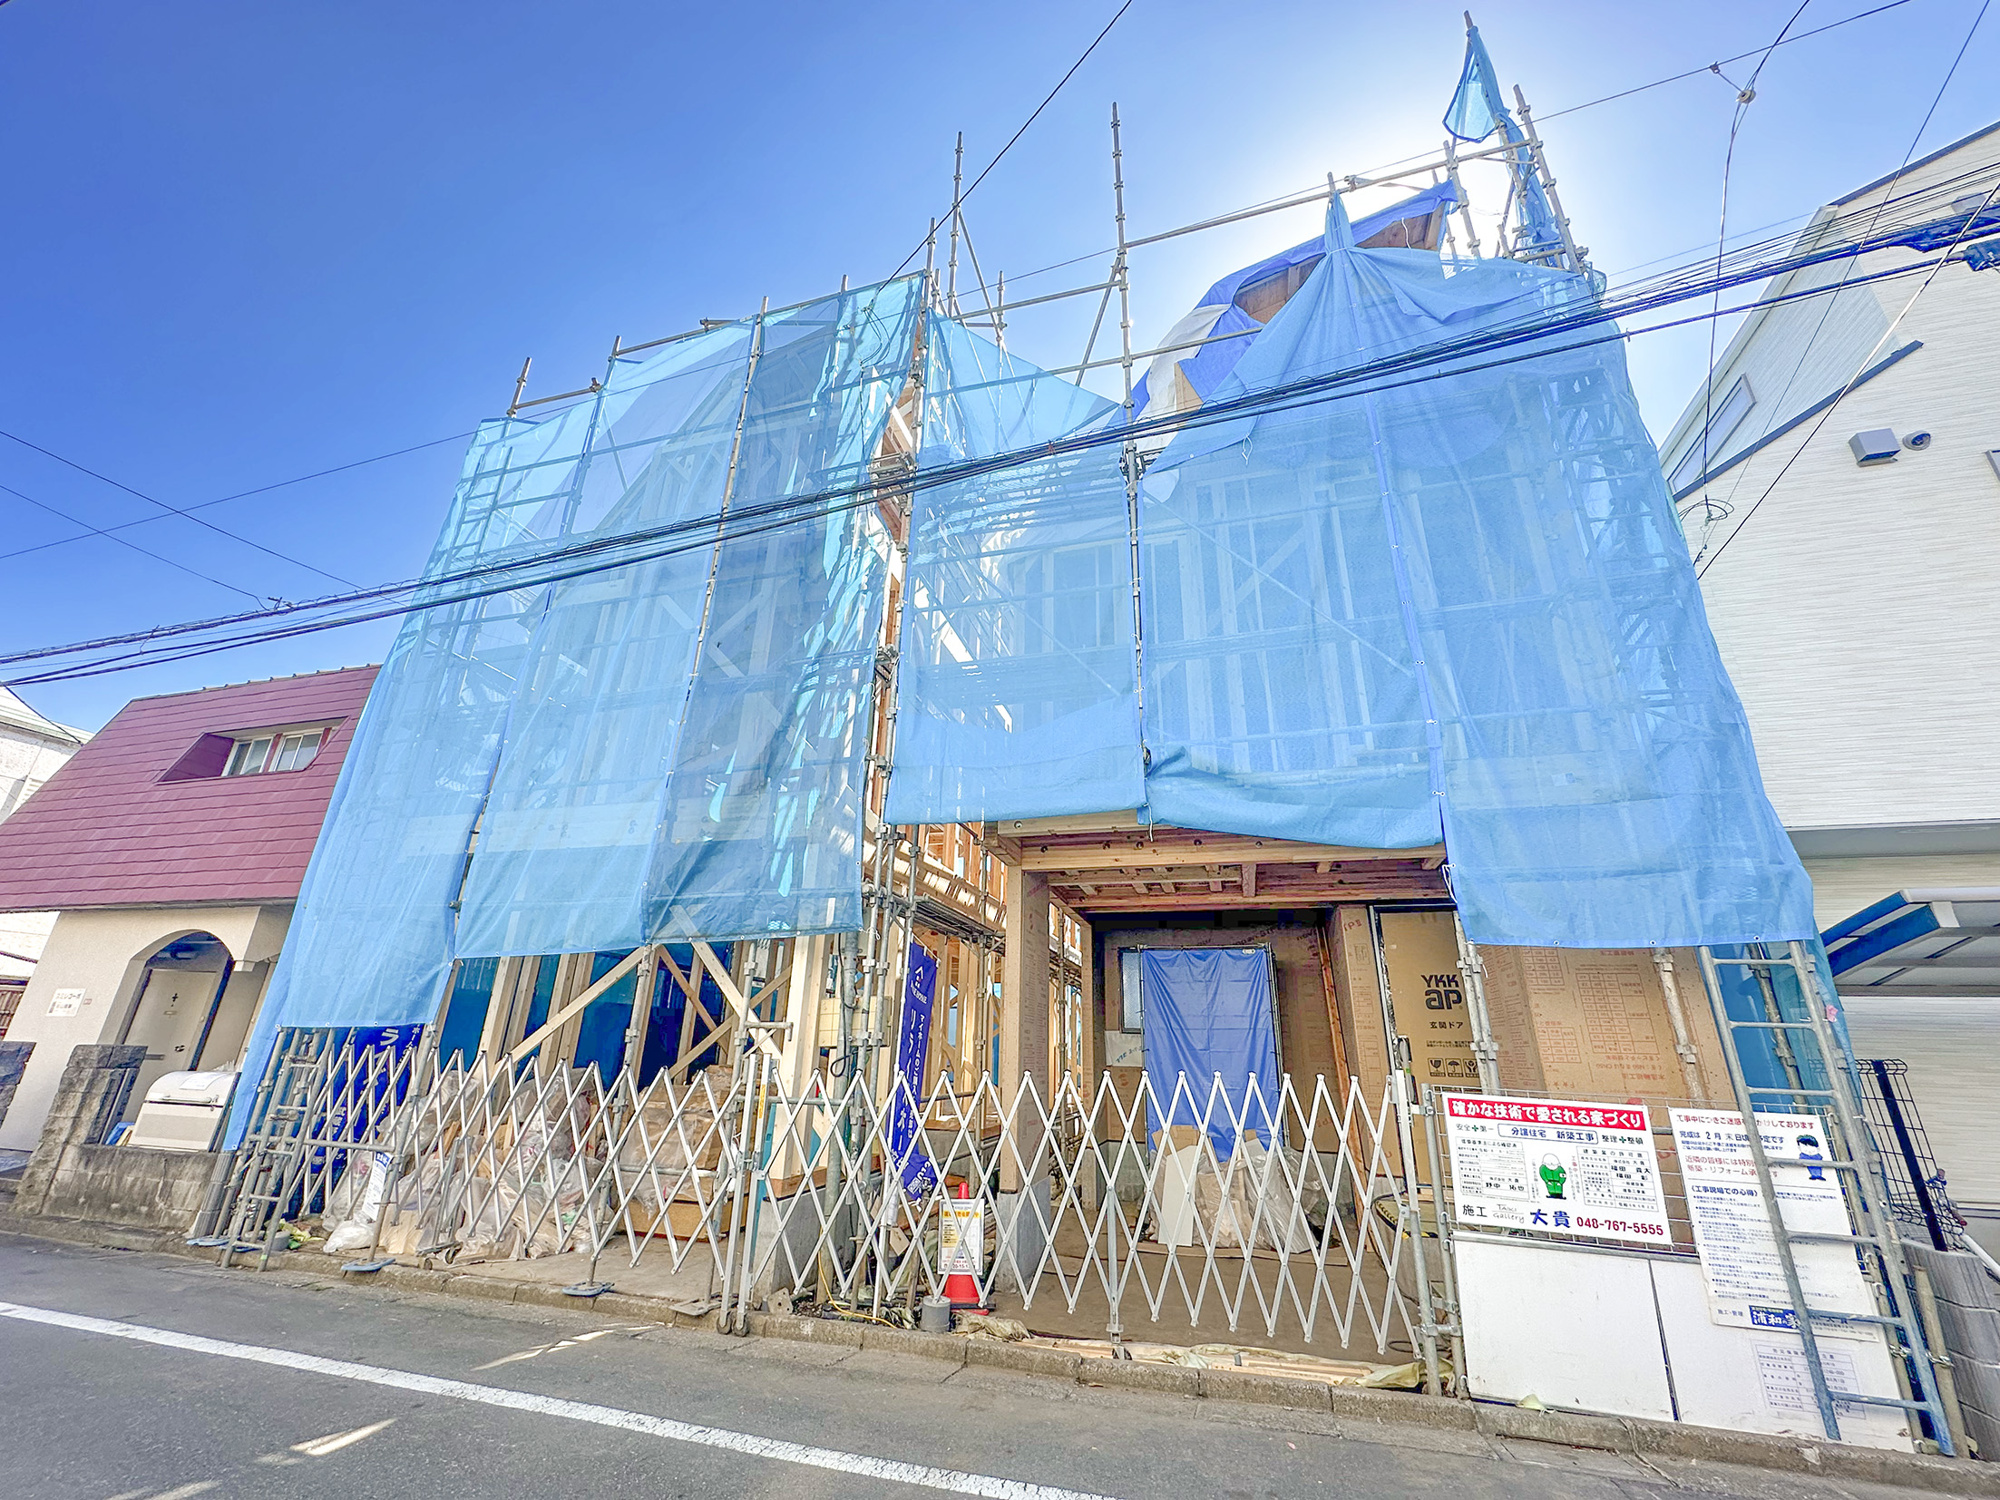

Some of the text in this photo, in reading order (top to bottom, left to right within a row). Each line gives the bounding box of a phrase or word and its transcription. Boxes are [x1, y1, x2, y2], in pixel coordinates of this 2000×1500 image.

[1421, 974, 1460, 988] YKK
[1424, 989, 1463, 1010] ap
[1430, 1021, 1464, 1029] 玄関ドア
[1452, 1100, 1641, 1128] 確かな技術で愛される家づくり
[1511, 1126, 1595, 1141] 分譲住宅 新築工事
[1679, 1131, 1701, 1139] 完成は
[1705, 1131, 1711, 1140] 2
[1714, 1132, 1722, 1141] 月
[1462, 1204, 1488, 1218] 施工
[1492, 1212, 1525, 1224] Gallery
[1529, 1208, 1571, 1228] 大貴
[1576, 1216, 1664, 1236] 048-767-5555
